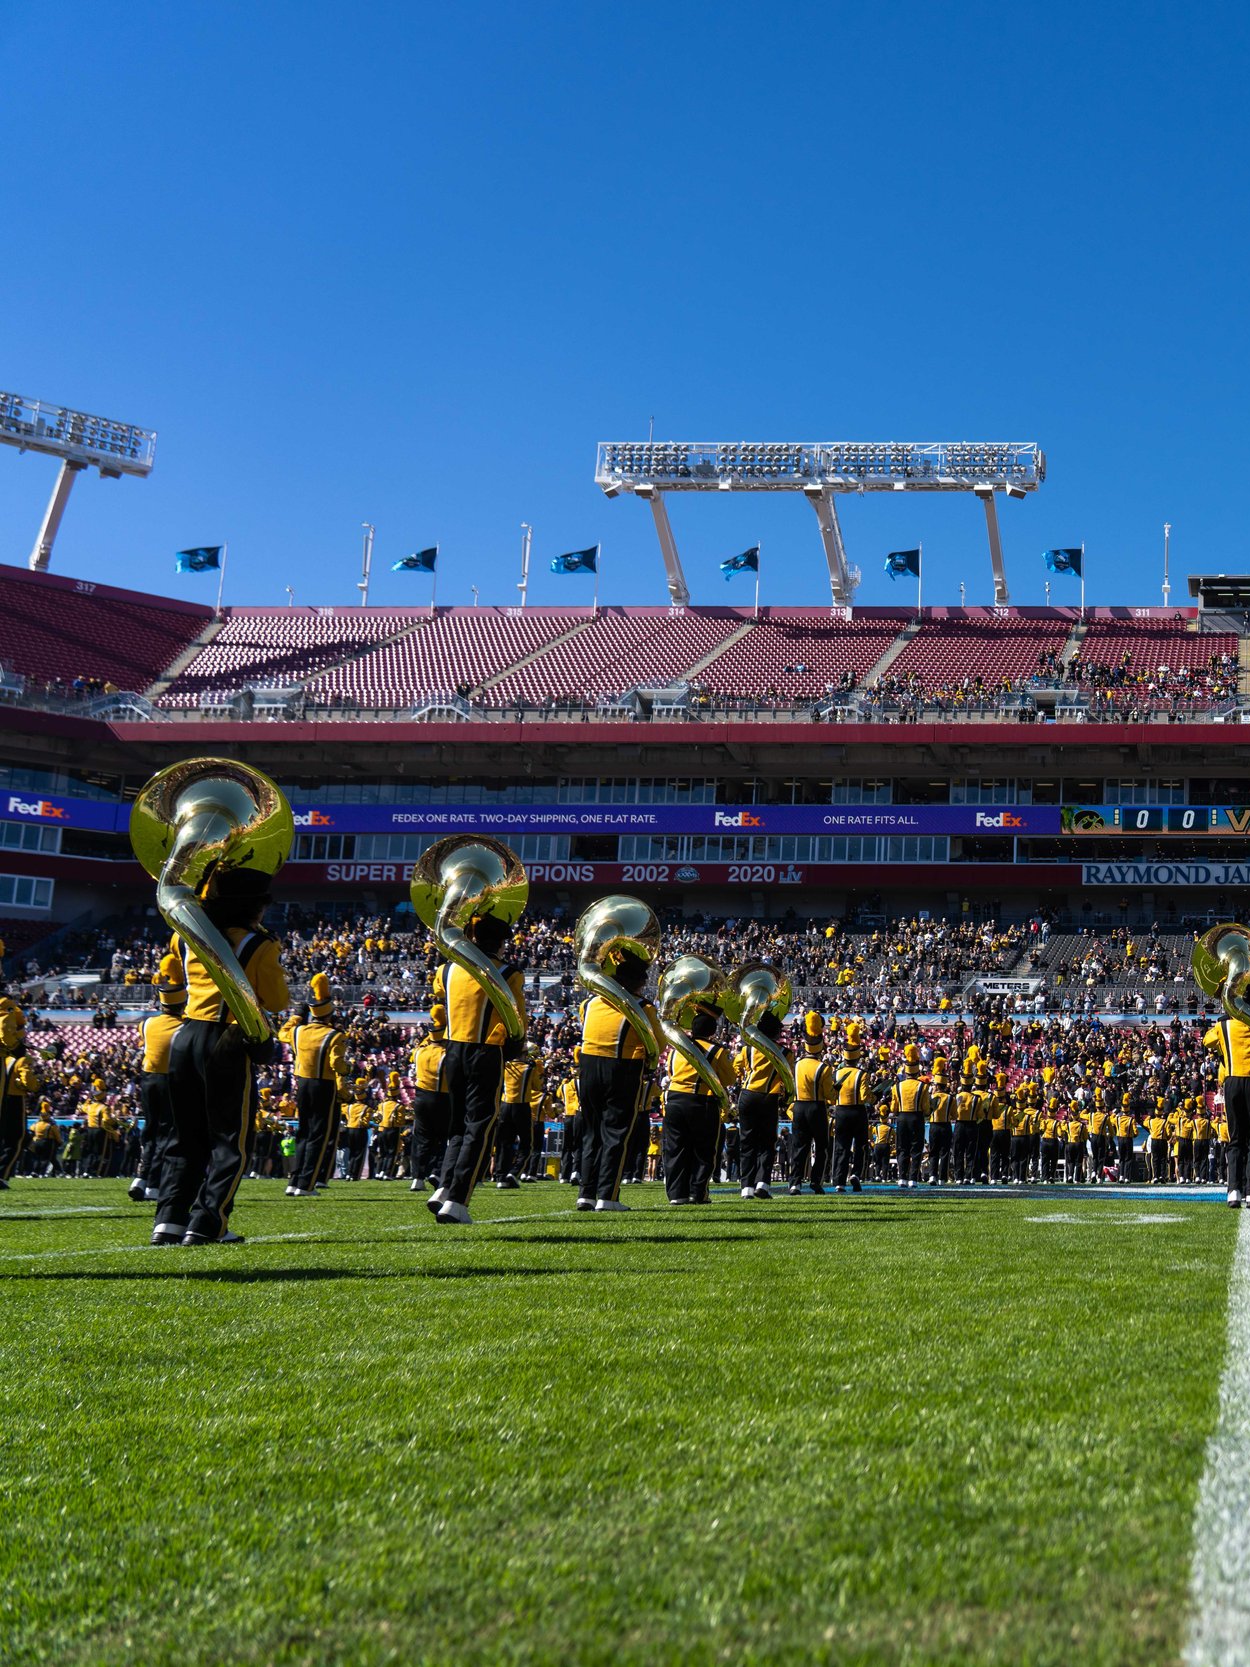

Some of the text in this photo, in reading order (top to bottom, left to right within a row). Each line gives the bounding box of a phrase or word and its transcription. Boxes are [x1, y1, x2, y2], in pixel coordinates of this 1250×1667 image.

[75, 581, 96, 593] 317
[318, 607, 334, 616] 316
[506, 607, 522, 616] 315
[668, 607, 685, 616] 314
[830, 608, 847, 616] 313
[993, 608, 1009, 616] 312
[1135, 608, 1150, 617] 311
[8, 797, 65, 818] FedEx
[293, 811, 331, 825] edEx
[392, 814, 658, 825] FEDEX ONE RATE. TWO-DAY SHIPPING, ONE FLAT RATE.
[715, 811, 760, 826] FedEx
[823, 816, 919, 824] ONE RATE FITS ALL.
[976, 812, 1022, 827] FedEx
[1136, 810, 1149, 829] 0
[1182, 810, 1195, 829] 0
[327, 865, 396, 882] SUPER
[527, 866, 594, 882] PIONS
[622, 866, 669, 882] 2002
[728, 866, 775, 882] 2020
[1084, 865, 1211, 884] RAYMOND
